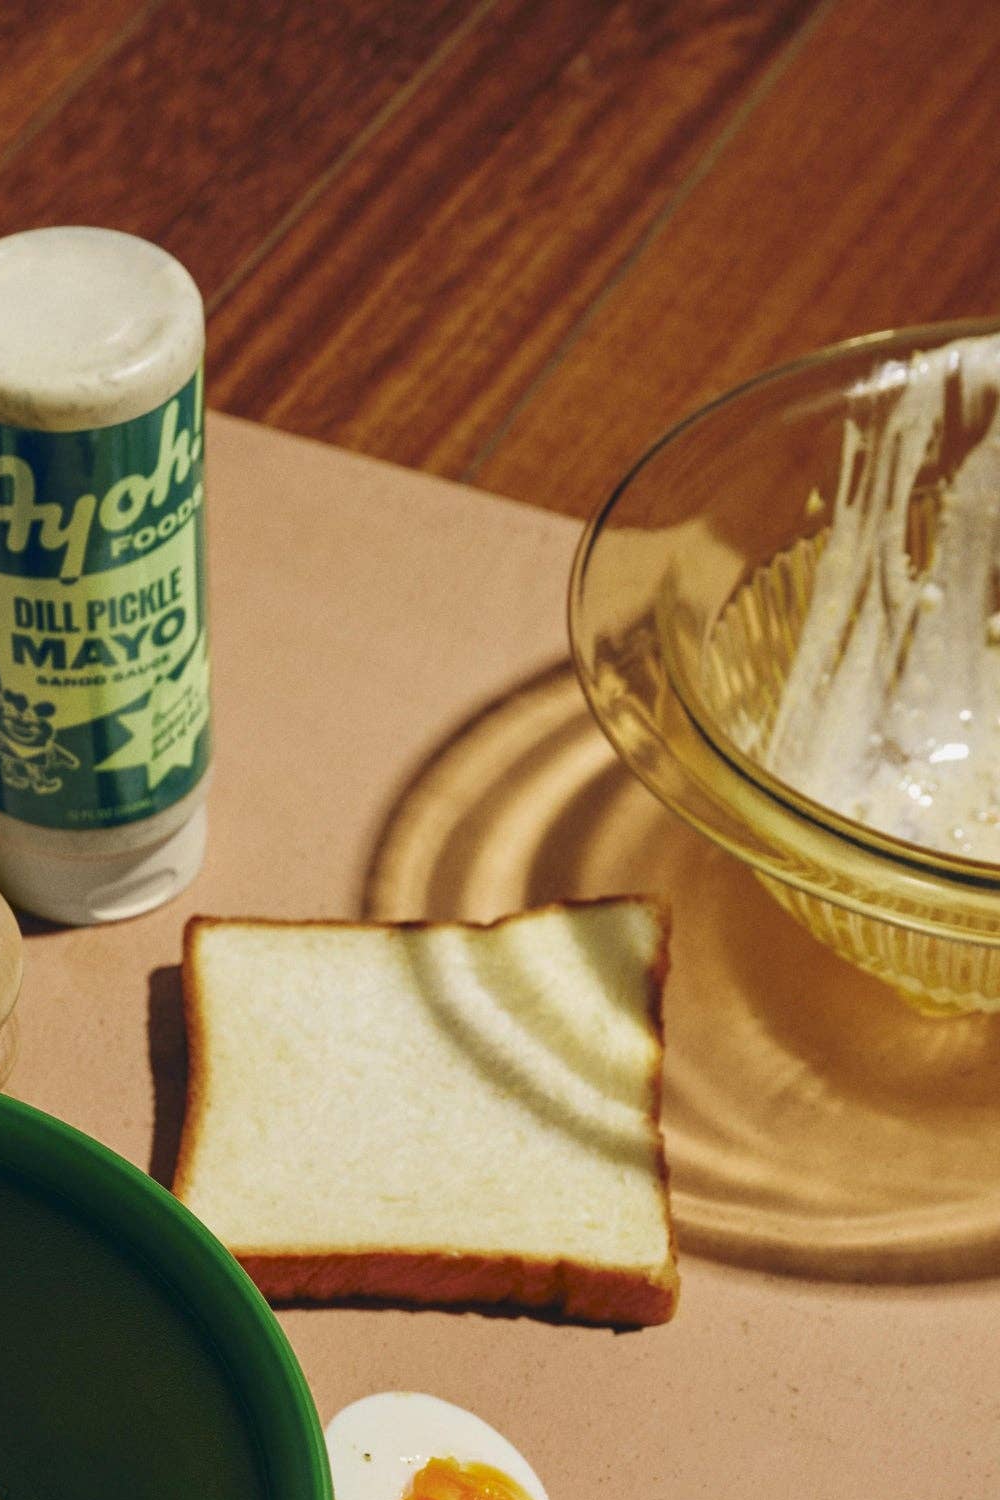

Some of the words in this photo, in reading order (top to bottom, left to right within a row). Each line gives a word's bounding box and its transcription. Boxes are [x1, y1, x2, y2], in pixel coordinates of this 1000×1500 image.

[13, 597, 80, 632] DILL
[87, 566, 182, 631] PICKLE
[12, 607, 186, 670] MAYO
